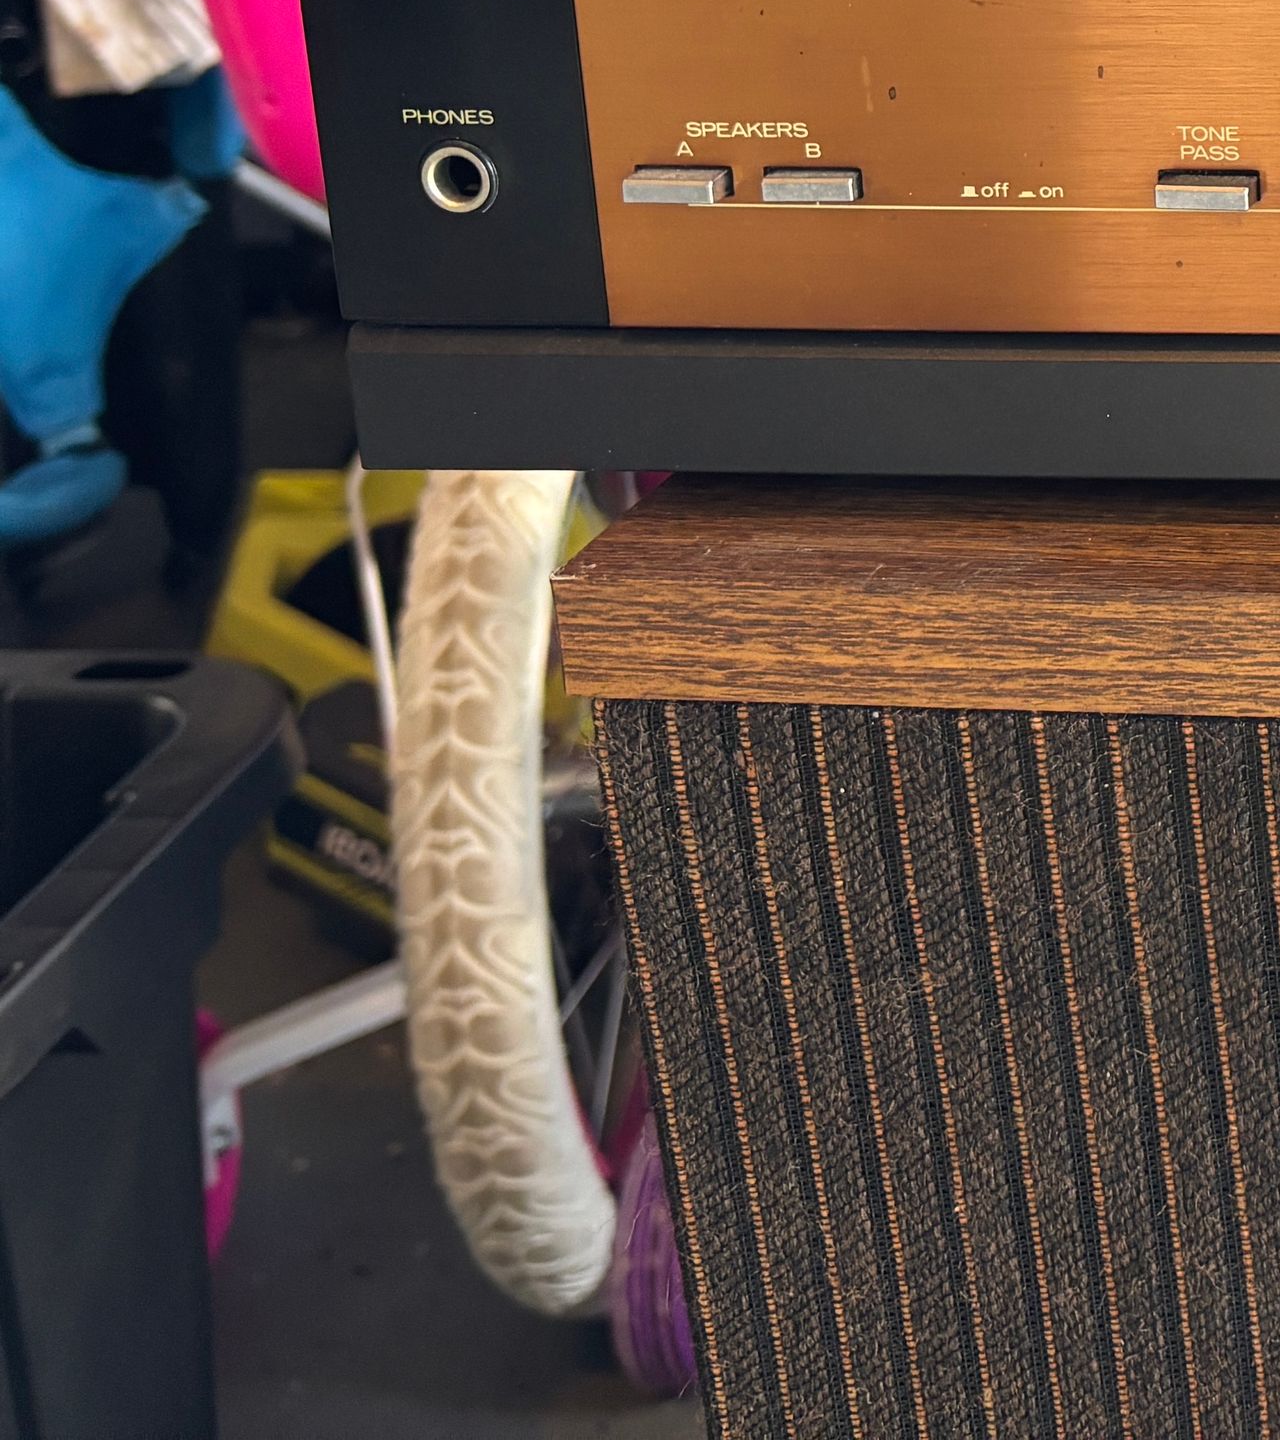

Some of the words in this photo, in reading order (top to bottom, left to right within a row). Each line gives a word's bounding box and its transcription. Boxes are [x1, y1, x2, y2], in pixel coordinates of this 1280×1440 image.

[402, 108, 495, 125] PHONES
[685, 121, 809, 138] SPEAKERS
[1175, 125, 1241, 142] TONE
[676, 140, 694, 157] A
[804, 142, 822, 159] B
[1180, 145, 1240, 162] PASS
[980, 182, 1010, 198] off
[1039, 186, 1064, 199] on
